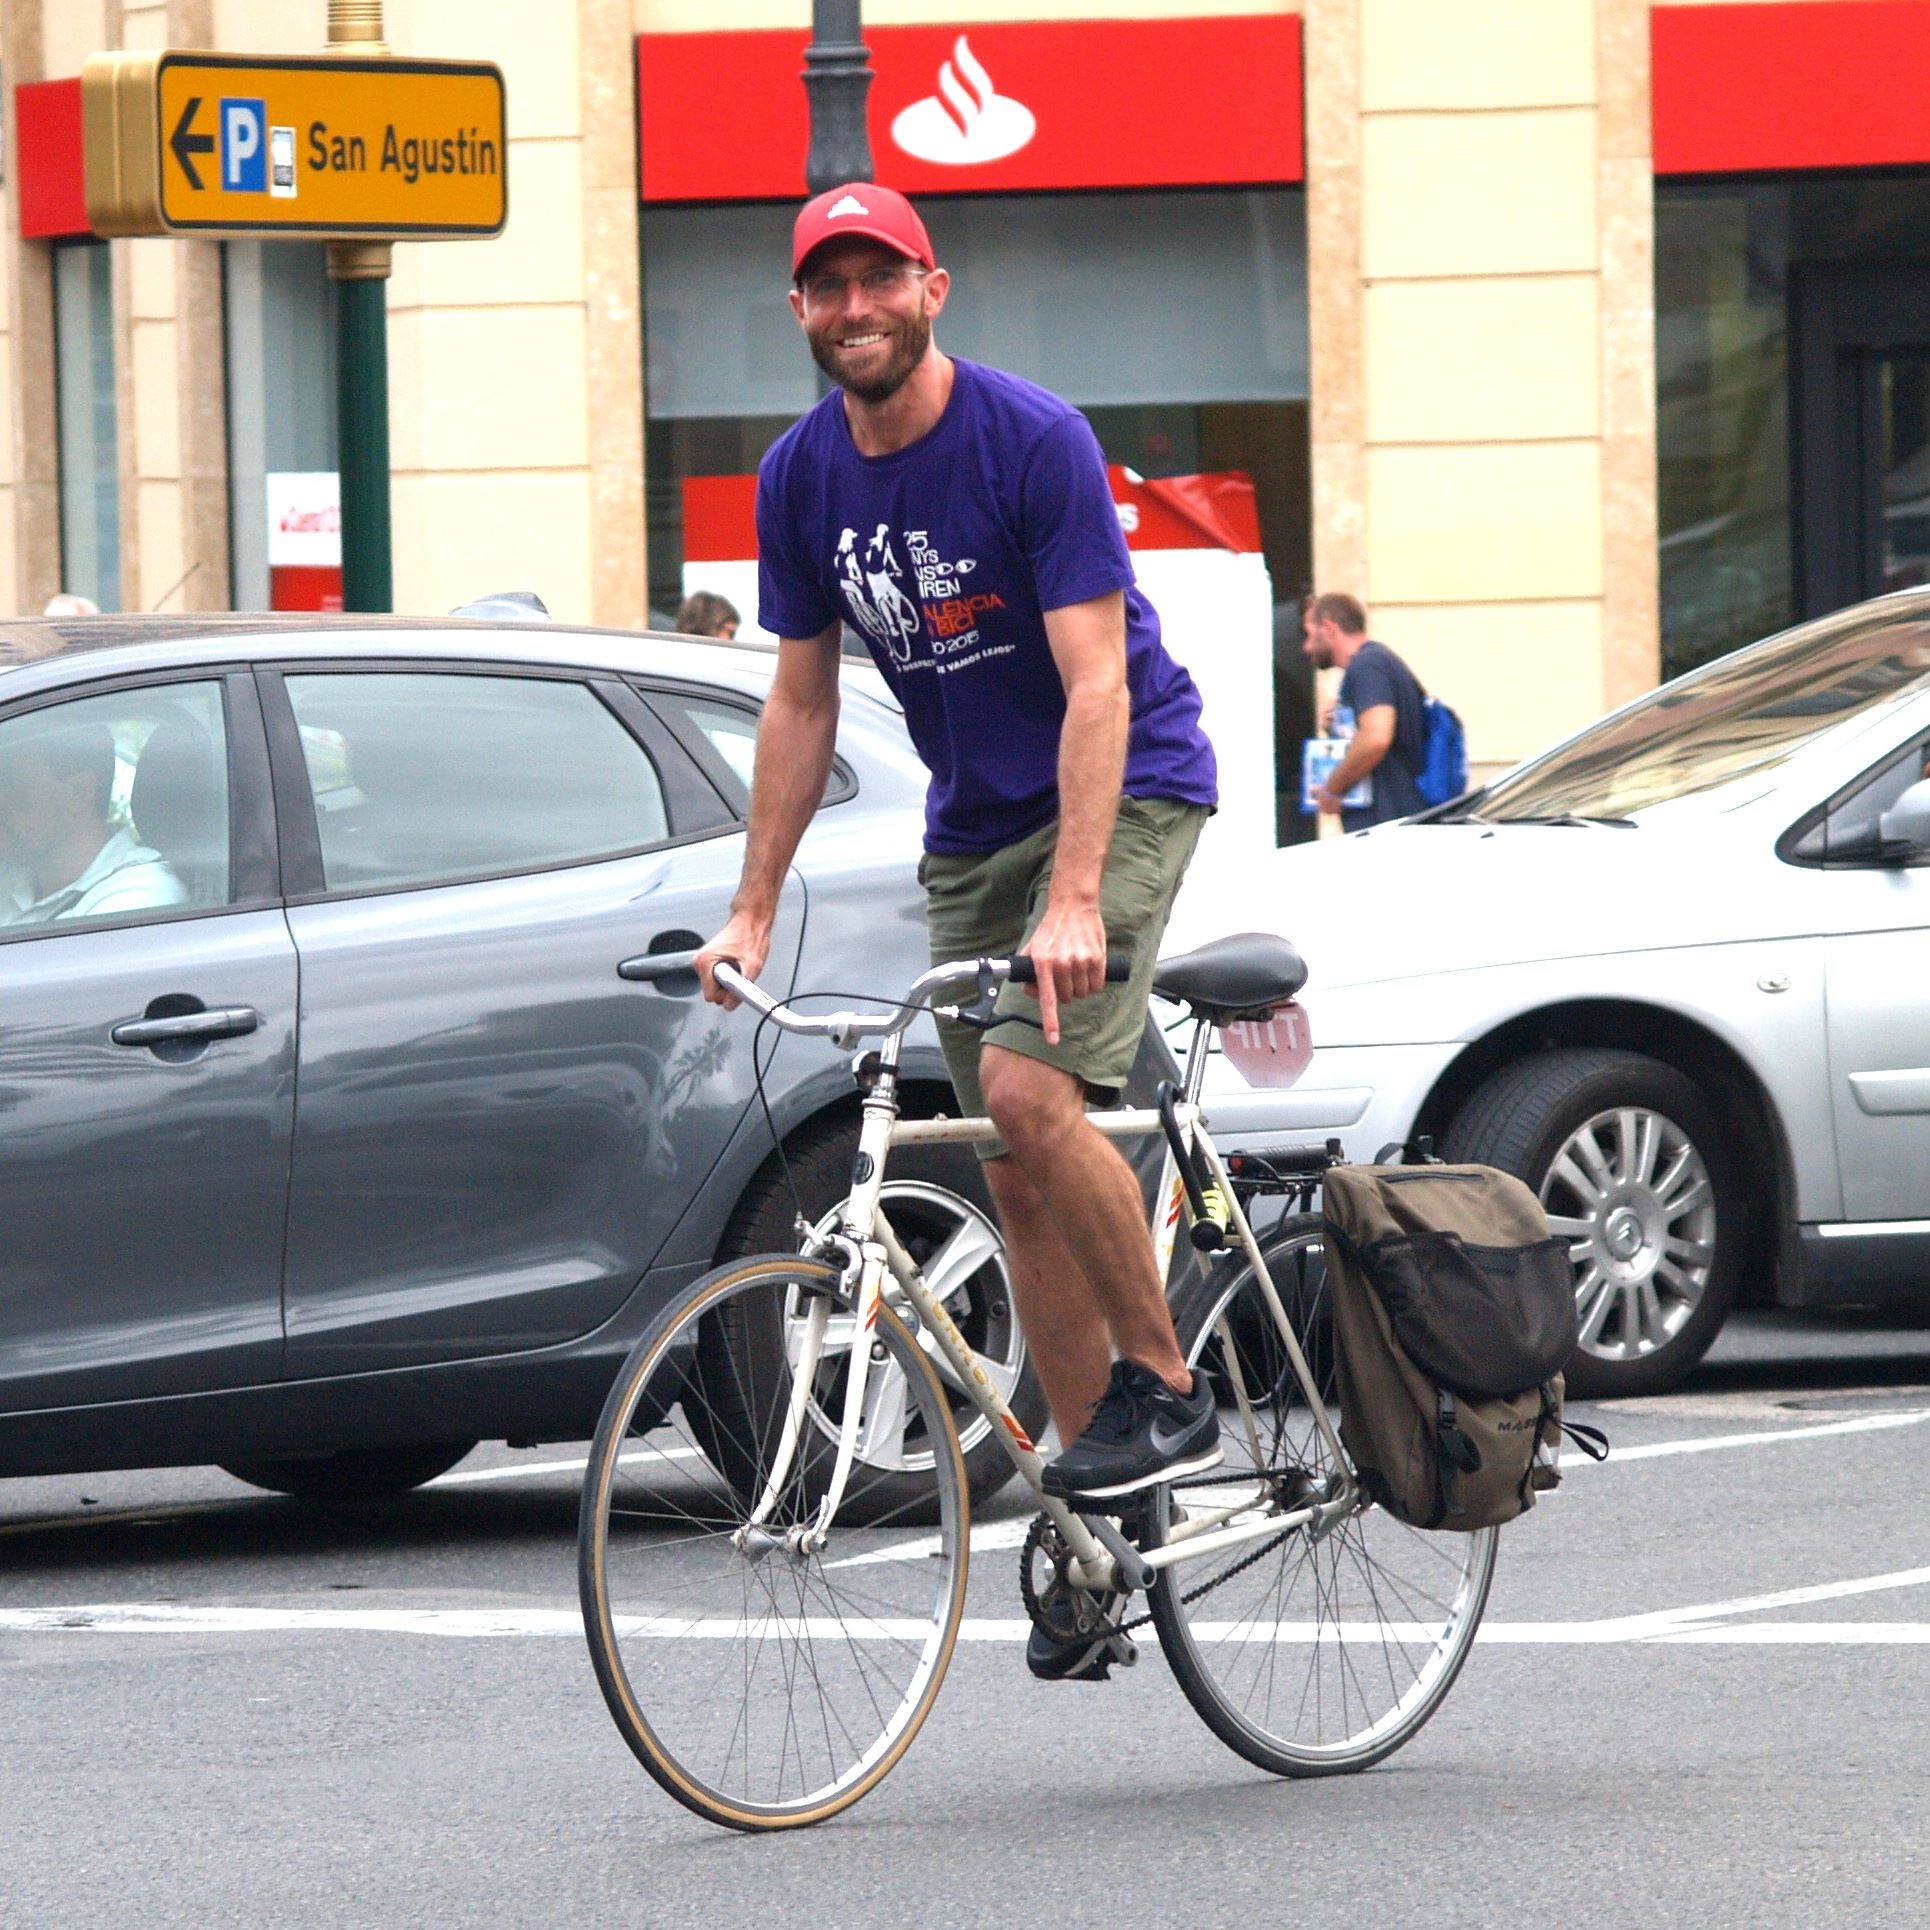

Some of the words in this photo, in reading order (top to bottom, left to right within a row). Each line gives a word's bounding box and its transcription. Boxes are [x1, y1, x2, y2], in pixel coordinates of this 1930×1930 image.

[227, 108, 259, 184] P
[308, 121, 366, 171] San
[380, 124, 497, 184] Agustín
[903, 531, 928, 551] 25
[911, 549, 939, 565] NYS
[919, 578, 961, 598] IREN
[946, 653, 981, 672] VAMOS
